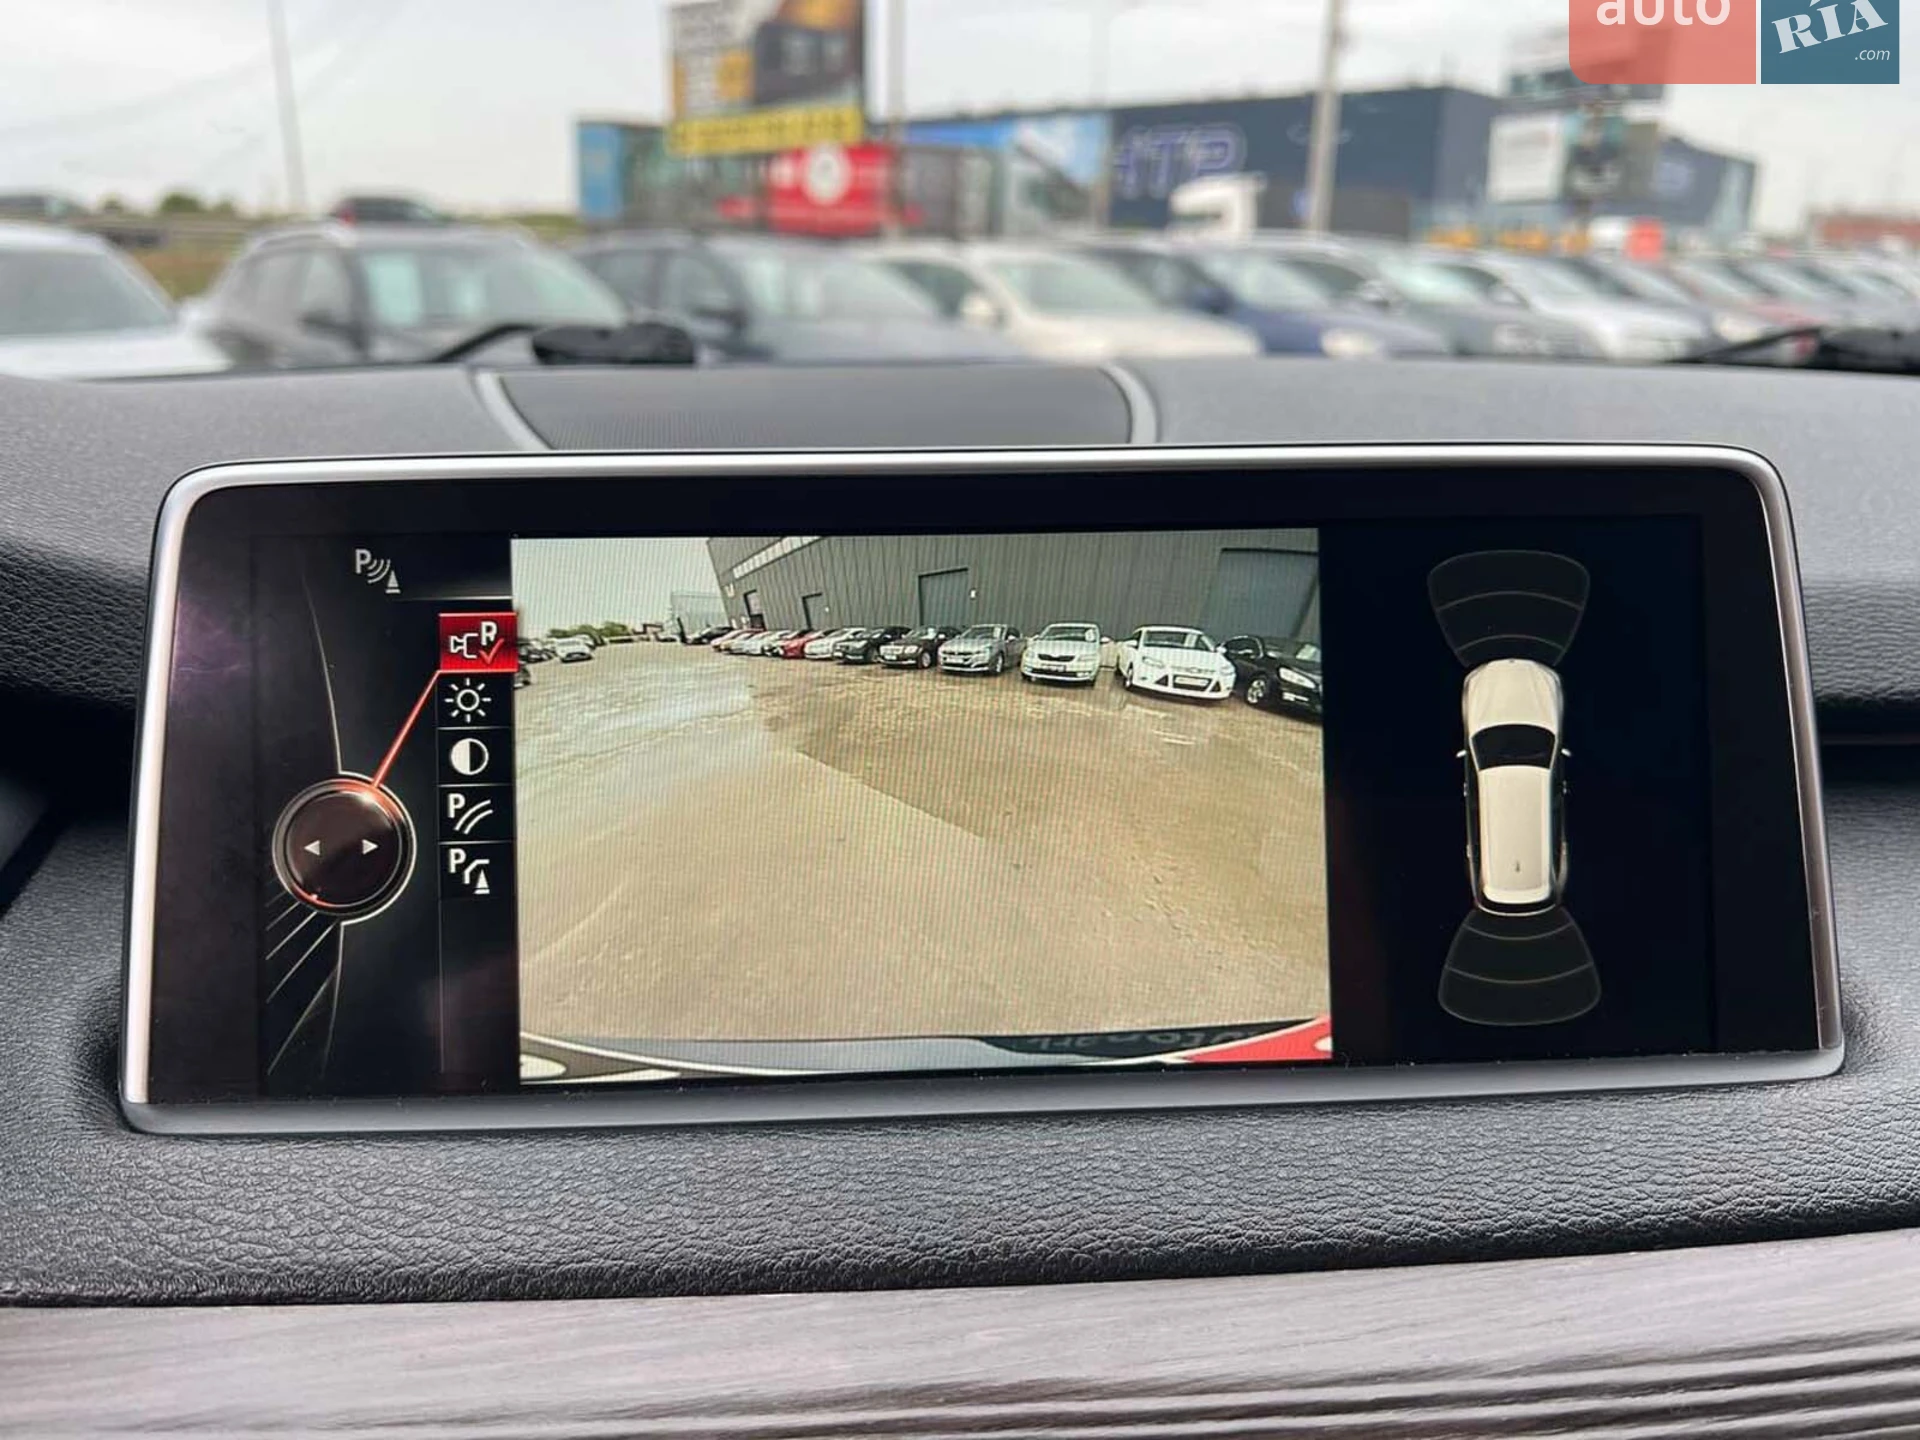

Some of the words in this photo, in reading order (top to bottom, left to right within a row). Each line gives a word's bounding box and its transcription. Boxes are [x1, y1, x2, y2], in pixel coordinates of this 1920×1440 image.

[355, 548, 372, 574] P
[448, 793, 466, 818] P
[449, 848, 467, 873] P
